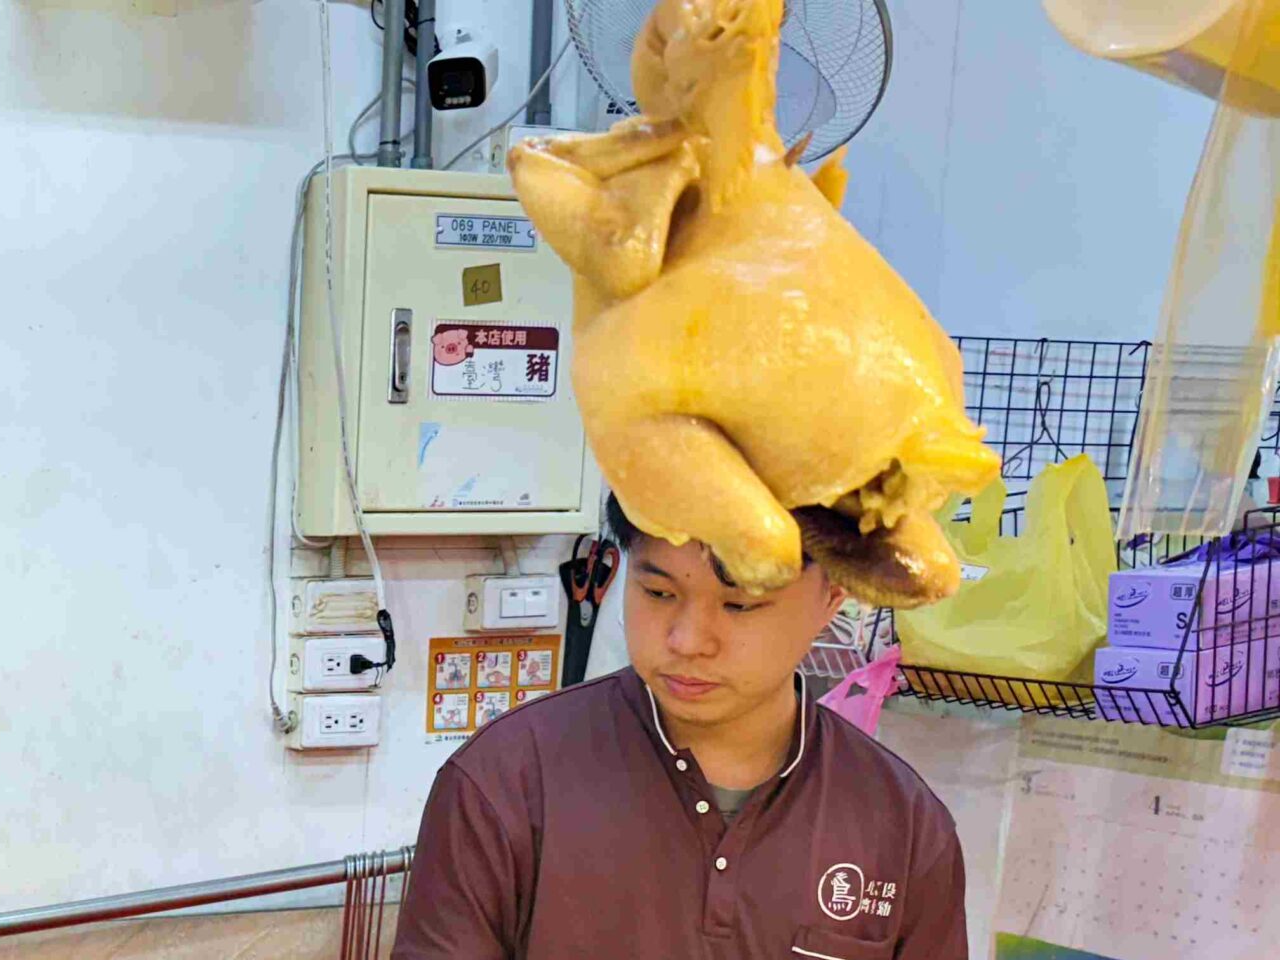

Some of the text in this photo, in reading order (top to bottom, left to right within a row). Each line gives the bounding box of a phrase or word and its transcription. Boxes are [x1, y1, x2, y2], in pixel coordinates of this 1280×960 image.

[451, 219, 520, 234] 069 PANEL
[470, 279, 490, 301] 40
[475, 329, 527, 345] 本店使用
[526, 353, 550, 382] 豬
[1176, 612, 1188, 630] S
